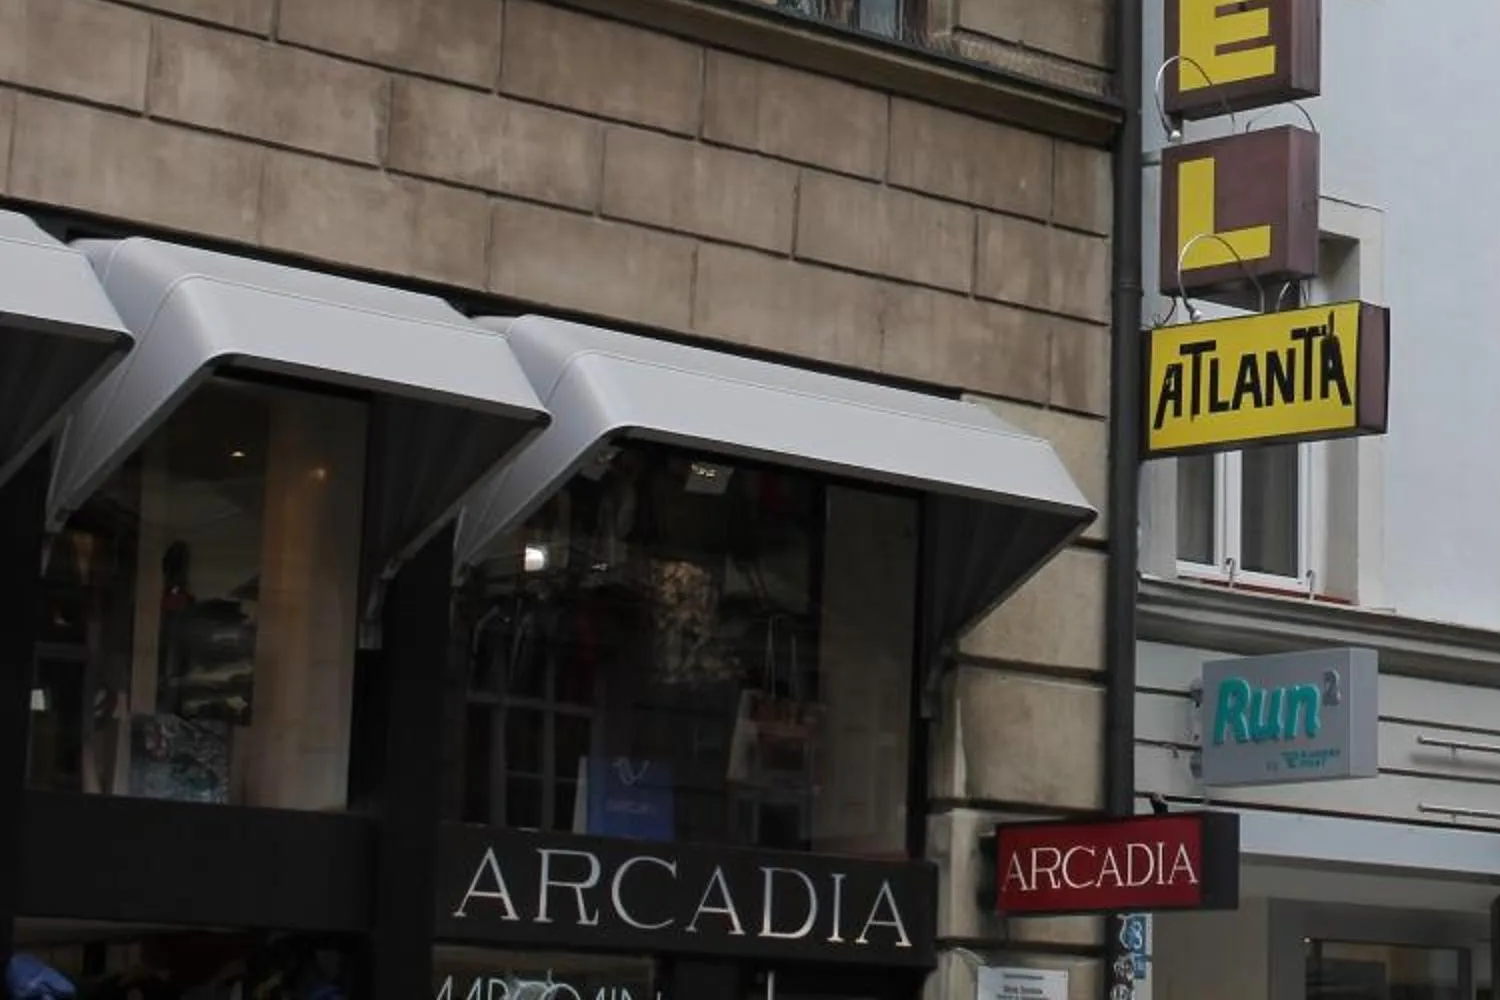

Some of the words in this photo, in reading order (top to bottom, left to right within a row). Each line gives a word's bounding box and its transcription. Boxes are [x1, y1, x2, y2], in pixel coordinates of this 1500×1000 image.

[1153, 312, 1352, 430] ATLANTA
[452, 846, 913, 948] ARCADIA
[1002, 842, 1200, 892] ARCADIA
